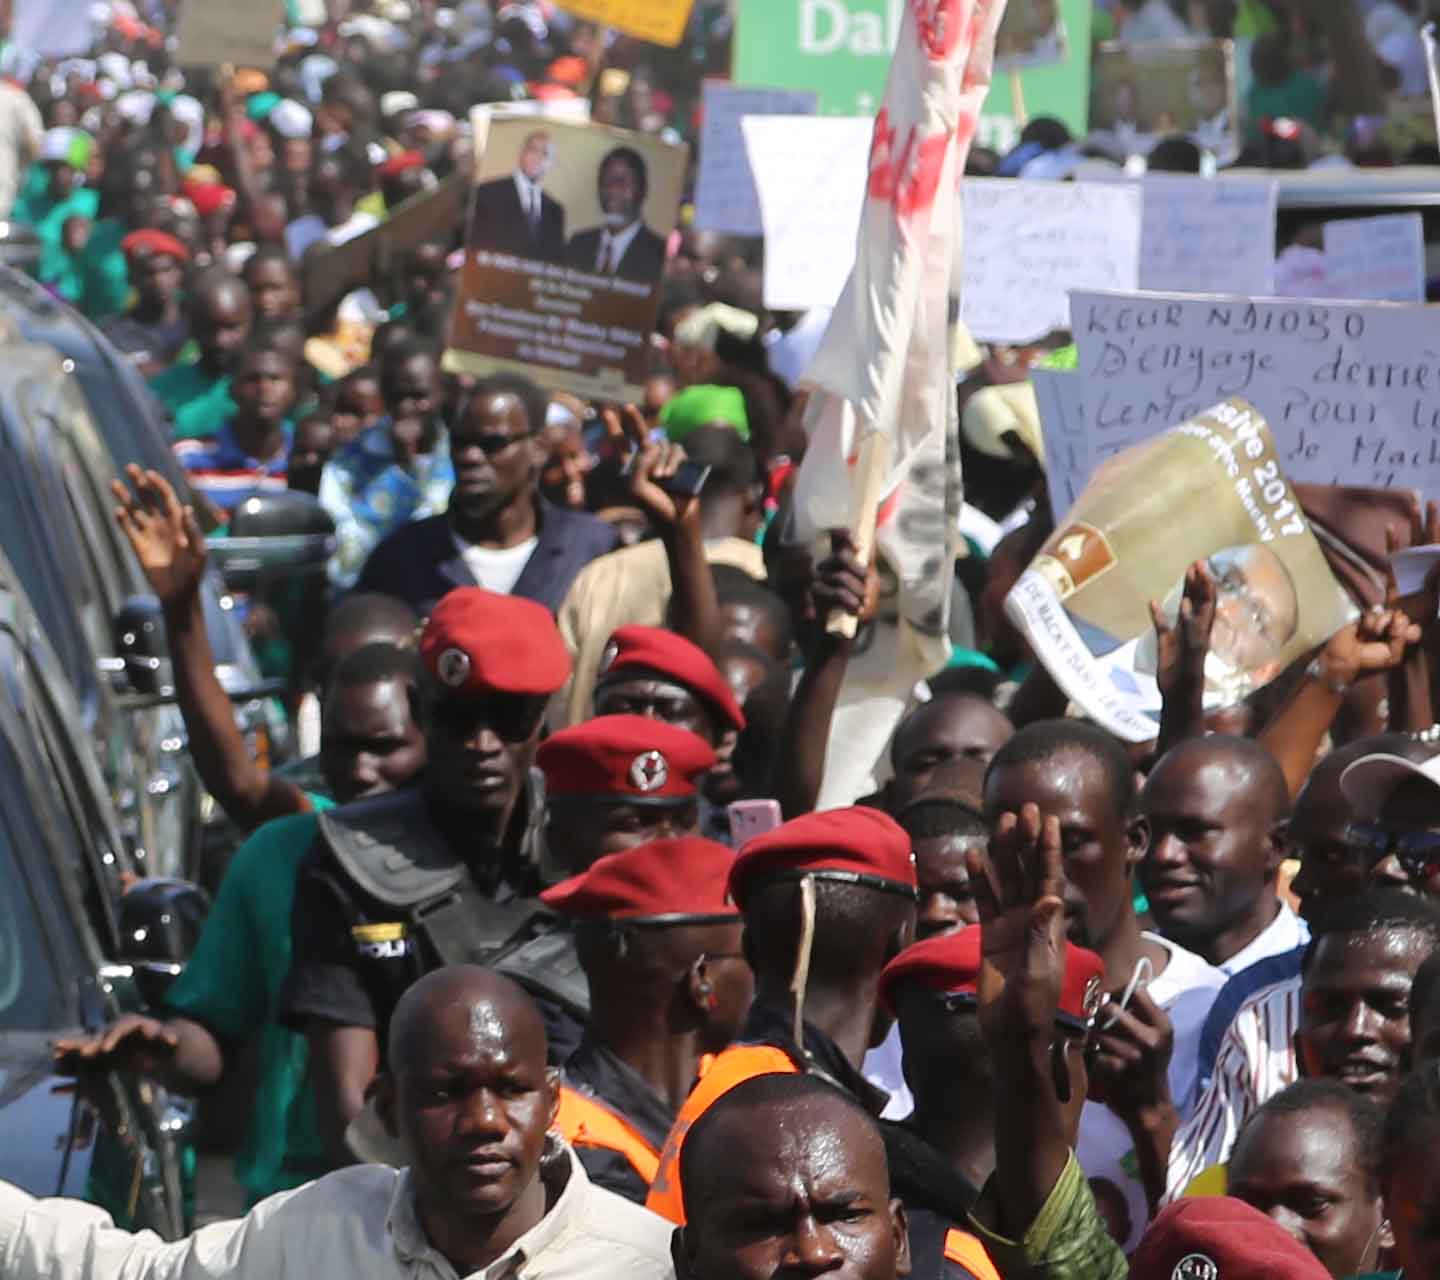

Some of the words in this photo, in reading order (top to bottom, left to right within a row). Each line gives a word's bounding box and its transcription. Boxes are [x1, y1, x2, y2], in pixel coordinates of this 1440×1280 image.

[1087, 303, 1186, 335] KEUR
[1252, 459, 1306, 537] 2017
[358, 938, 406, 960] POLI
